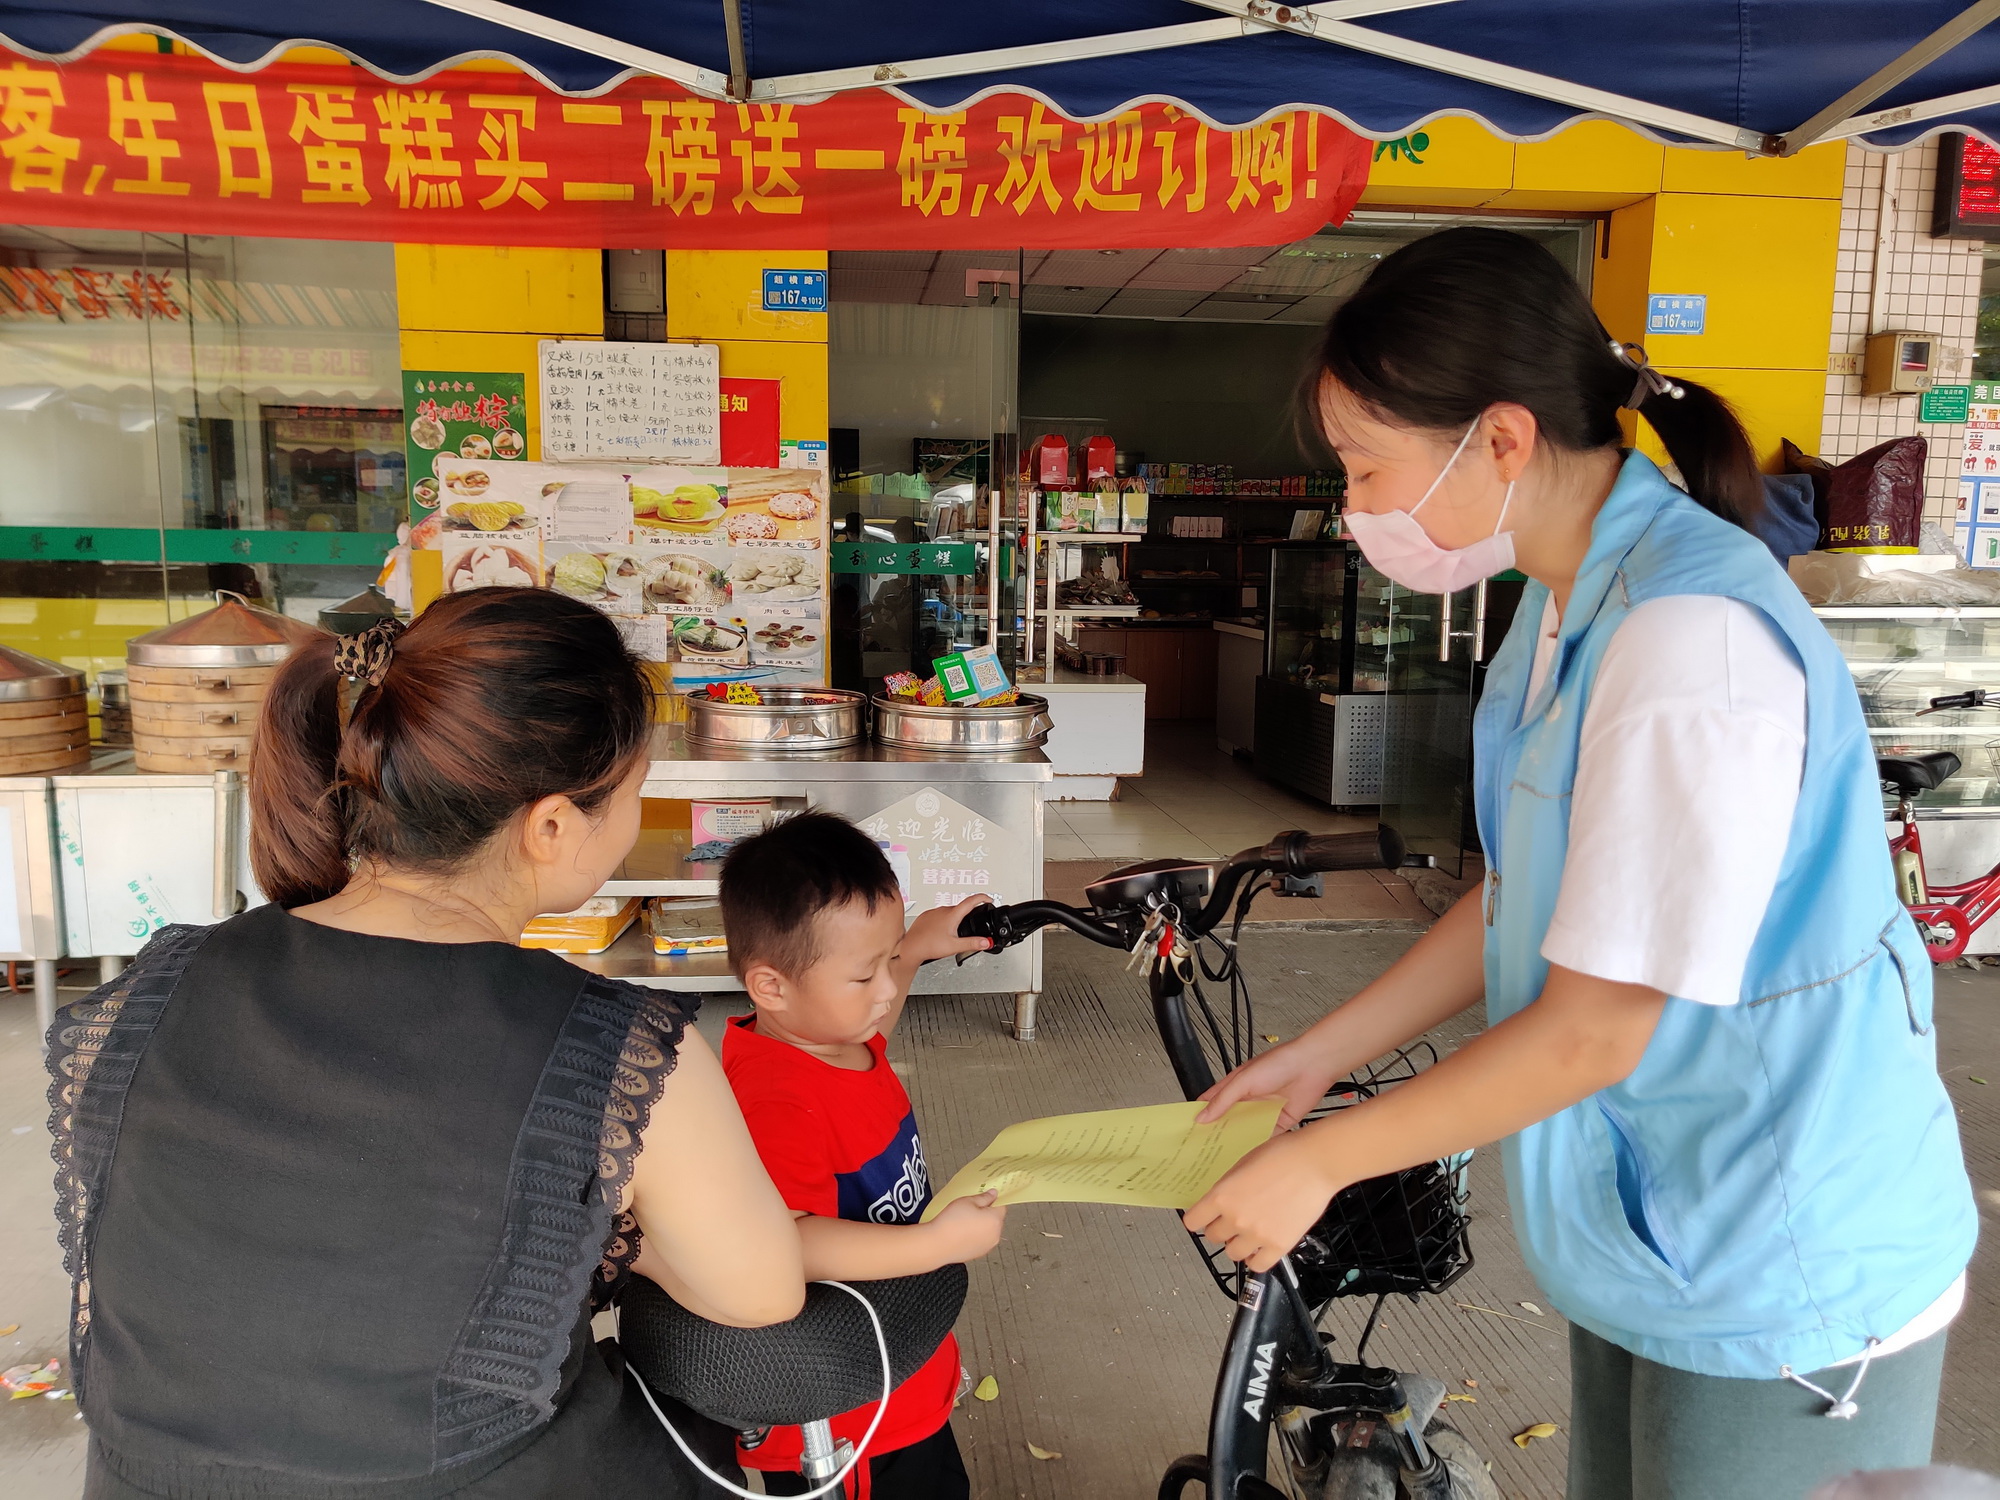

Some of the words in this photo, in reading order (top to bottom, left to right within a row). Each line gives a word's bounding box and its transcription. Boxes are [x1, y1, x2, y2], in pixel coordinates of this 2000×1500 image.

[781, 290, 823, 305] 167号1012
[1820, 525, 1890, 541] 乳猪配
[850, 549, 953, 568] 甜心蛋糕
[866, 816, 987, 843] 欢迎光临
[918, 844, 989, 864] 娃哈哈
[922, 868, 990, 886] 营养五谷
[934, 891, 1003, 907] 美味
[1243, 1341, 1278, 1423] AIMA
